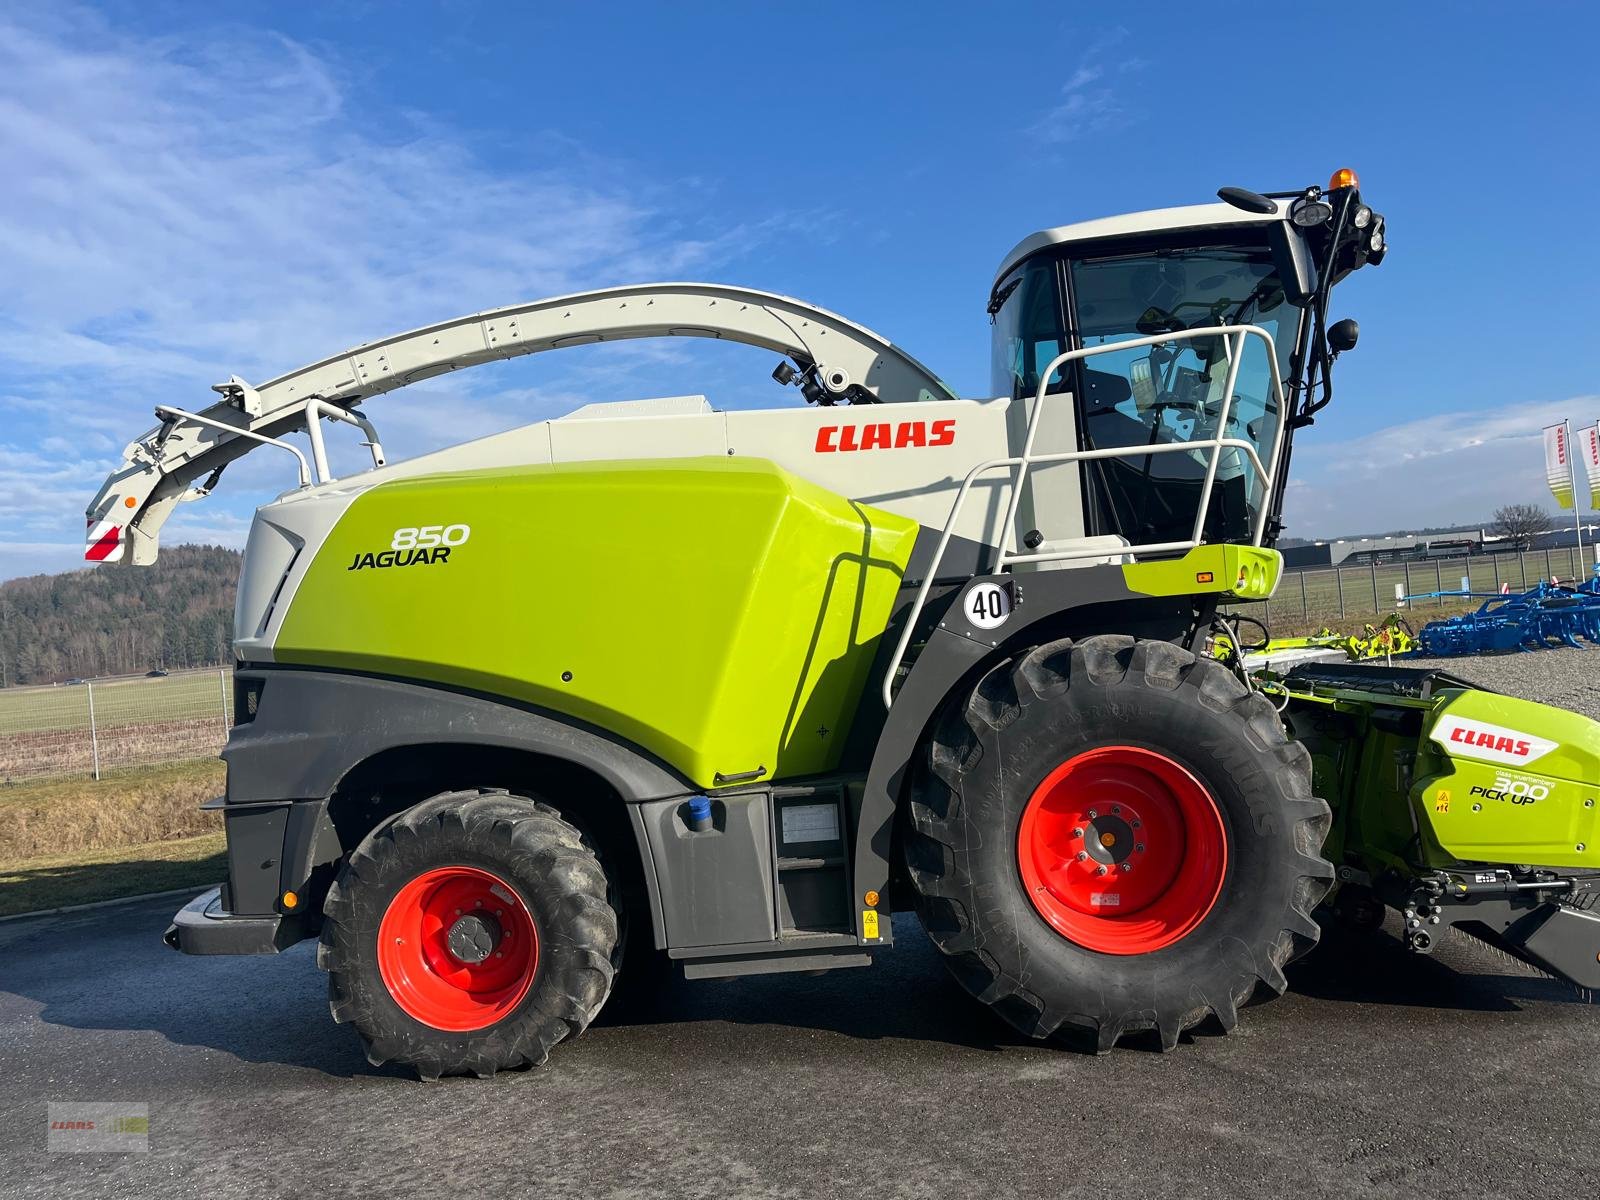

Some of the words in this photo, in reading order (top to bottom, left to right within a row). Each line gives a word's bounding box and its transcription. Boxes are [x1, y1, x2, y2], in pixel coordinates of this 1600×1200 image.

[815, 420, 956, 452] CLAAS
[391, 524, 471, 550] 850
[347, 547, 451, 571] JAGUAR
[972, 590, 1001, 619] 40
[1450, 728, 1531, 756] CLAAS
[1470, 786, 1509, 802] PICK
[1511, 794, 1535, 806] UP
[1491, 777, 1549, 801] 300
